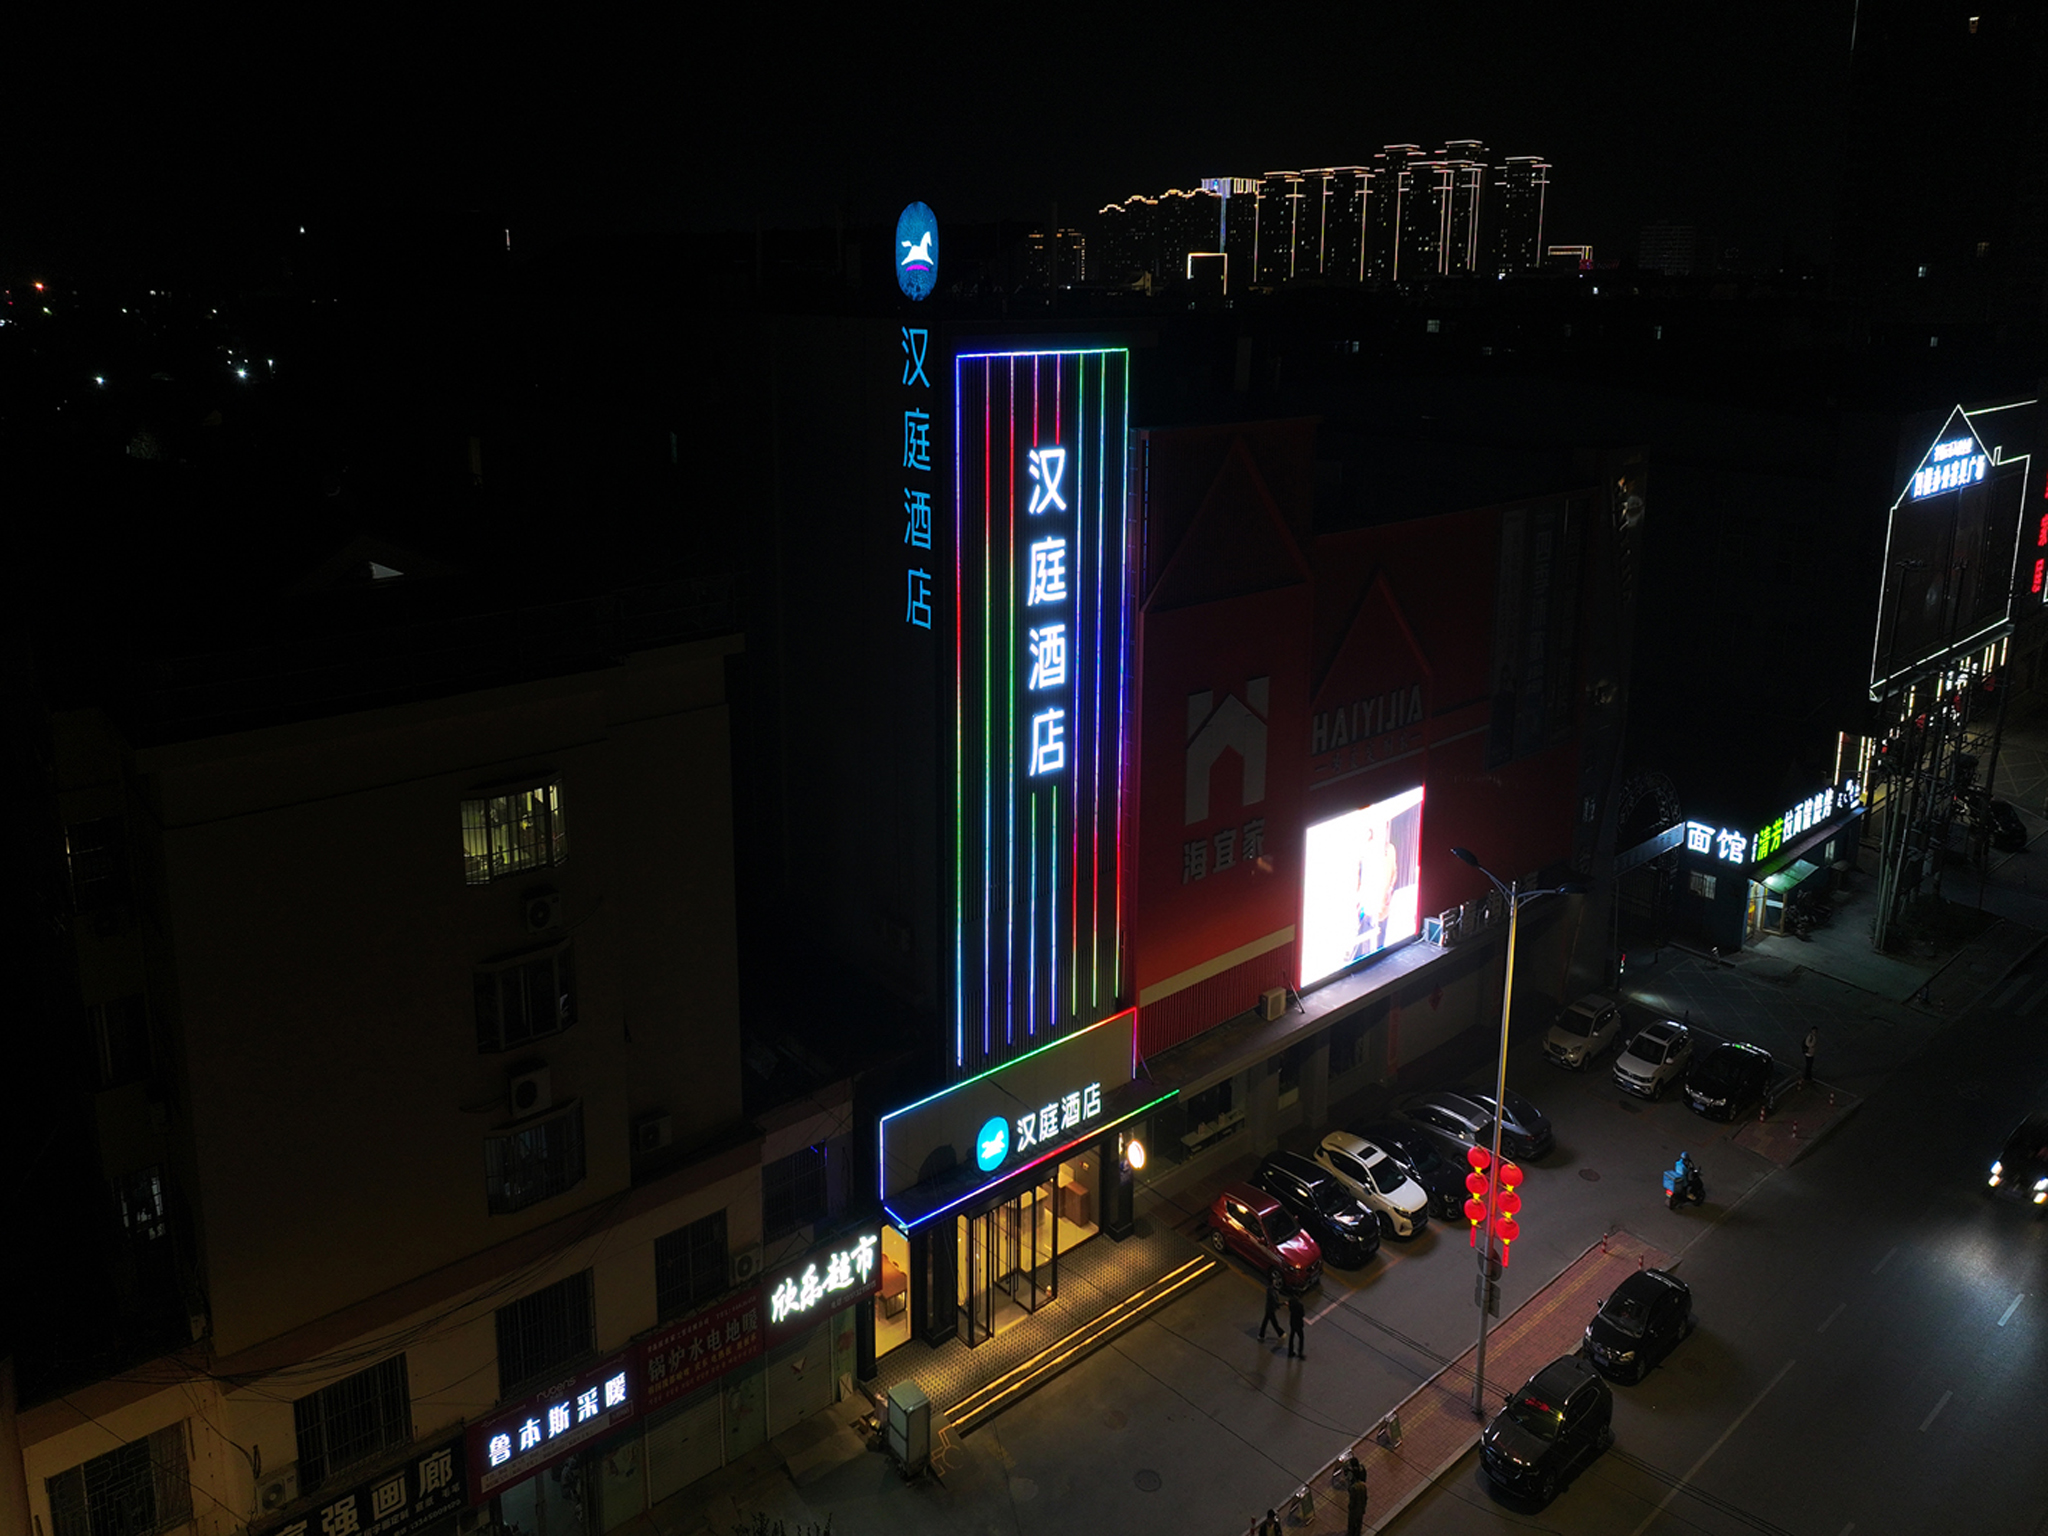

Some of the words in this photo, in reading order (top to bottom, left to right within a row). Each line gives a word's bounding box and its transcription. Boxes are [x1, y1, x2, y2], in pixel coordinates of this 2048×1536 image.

[900, 325, 932, 631] 汉庭酒店
[1028, 446, 1067, 777] 汉庭酒店
[1311, 684, 1424, 756] HAIYIJIA
[1181, 818, 1266, 885] 海宜家
[1686, 820, 1748, 865] 面馆
[1016, 1081, 1103, 1153] 汉庭酒店
[771, 1234, 878, 1324] 欣乐超市
[647, 1308, 758, 1382] 锅炉水电地暖
[488, 1371, 627, 1468] 鲁本斯采暖
